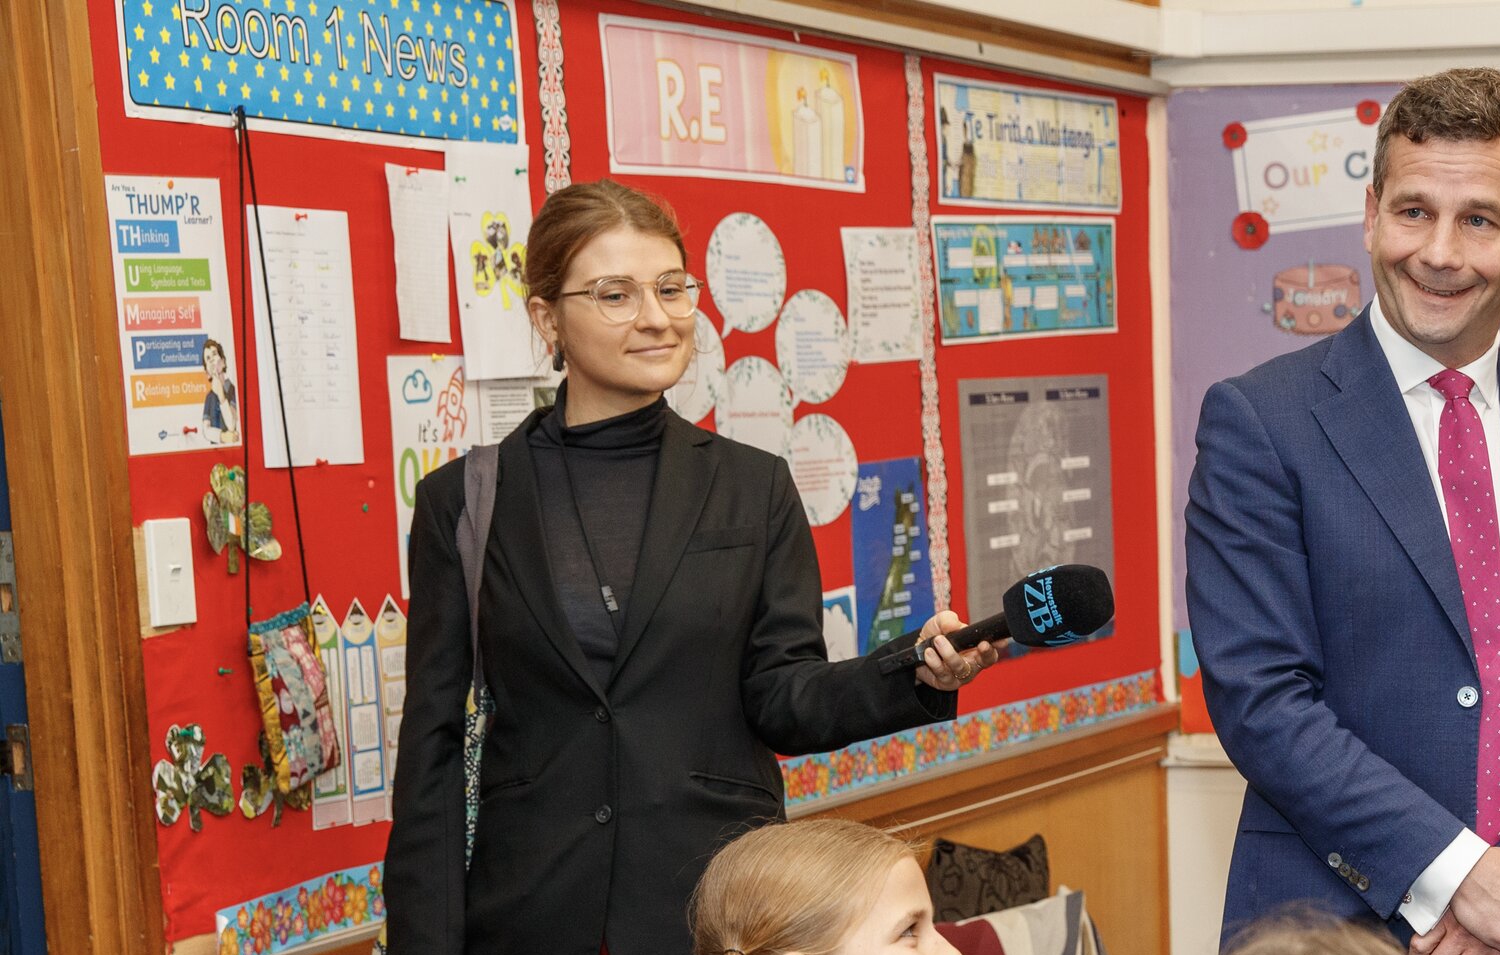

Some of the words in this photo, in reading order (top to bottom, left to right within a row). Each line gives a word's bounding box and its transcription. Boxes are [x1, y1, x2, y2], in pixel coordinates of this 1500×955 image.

[178, 0, 311, 65] Room
[324, 6, 344, 71] 1
[361, 10, 470, 89] News
[656, 58, 728, 143] R.E
[1263, 162, 1329, 189] Our
[111, 184, 120, 192] Are
[121, 184, 131, 192] You
[125, 192, 201, 216] THUMP'R
[184, 215, 213, 225] Learner?
[119, 224, 170, 248] THinking
[128, 264, 152, 287] Using
[151, 278, 176, 289] Symbols
[177, 278, 189, 287] and
[190, 277, 206, 287] Texts
[126, 303, 176, 326] Managing
[178, 304, 196, 323] Self
[135, 339, 181, 362] Participating
[182, 338, 195, 348] and
[161, 353, 200, 364] Contributing
[135, 380, 170, 401] Relating
[172, 384, 180, 394] to
[182, 382, 207, 393] Others
[418, 419, 438, 443] It's
[1023, 578, 1055, 634] ZB
[1044, 576, 1063, 626] Newstalk
